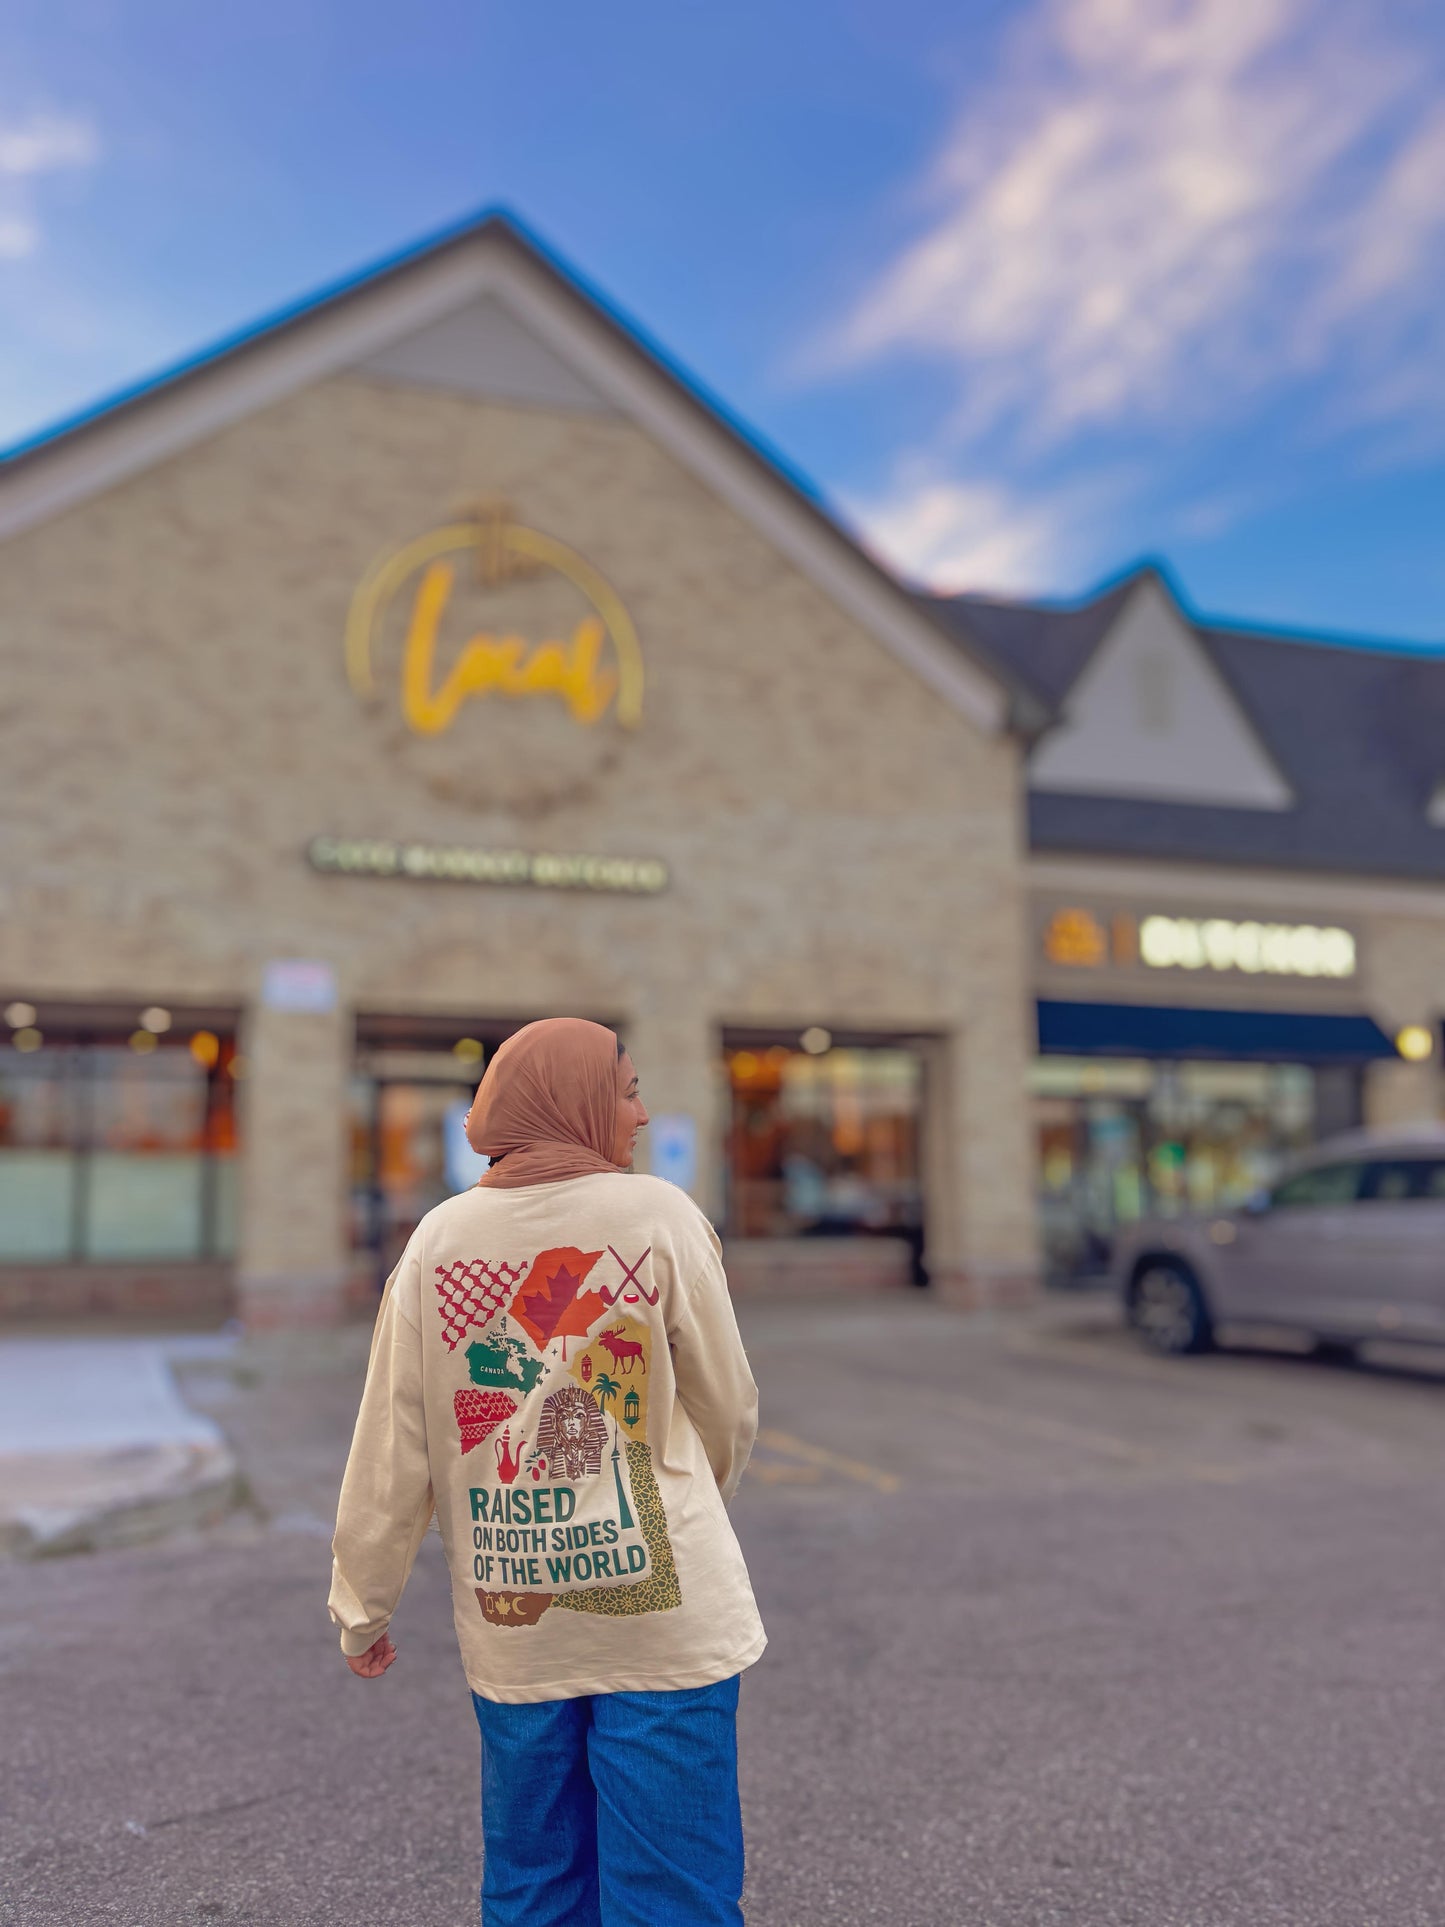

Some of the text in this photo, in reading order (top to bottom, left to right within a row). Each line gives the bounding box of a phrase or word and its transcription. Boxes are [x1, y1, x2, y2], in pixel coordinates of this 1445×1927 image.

[480, 1365, 505, 1375] CANADA
[469, 1487, 576, 1526] RAISED
[473, 1519, 619, 1553] ON BOTH SIDES
[474, 1545, 647, 1585] OF THE WORLD
